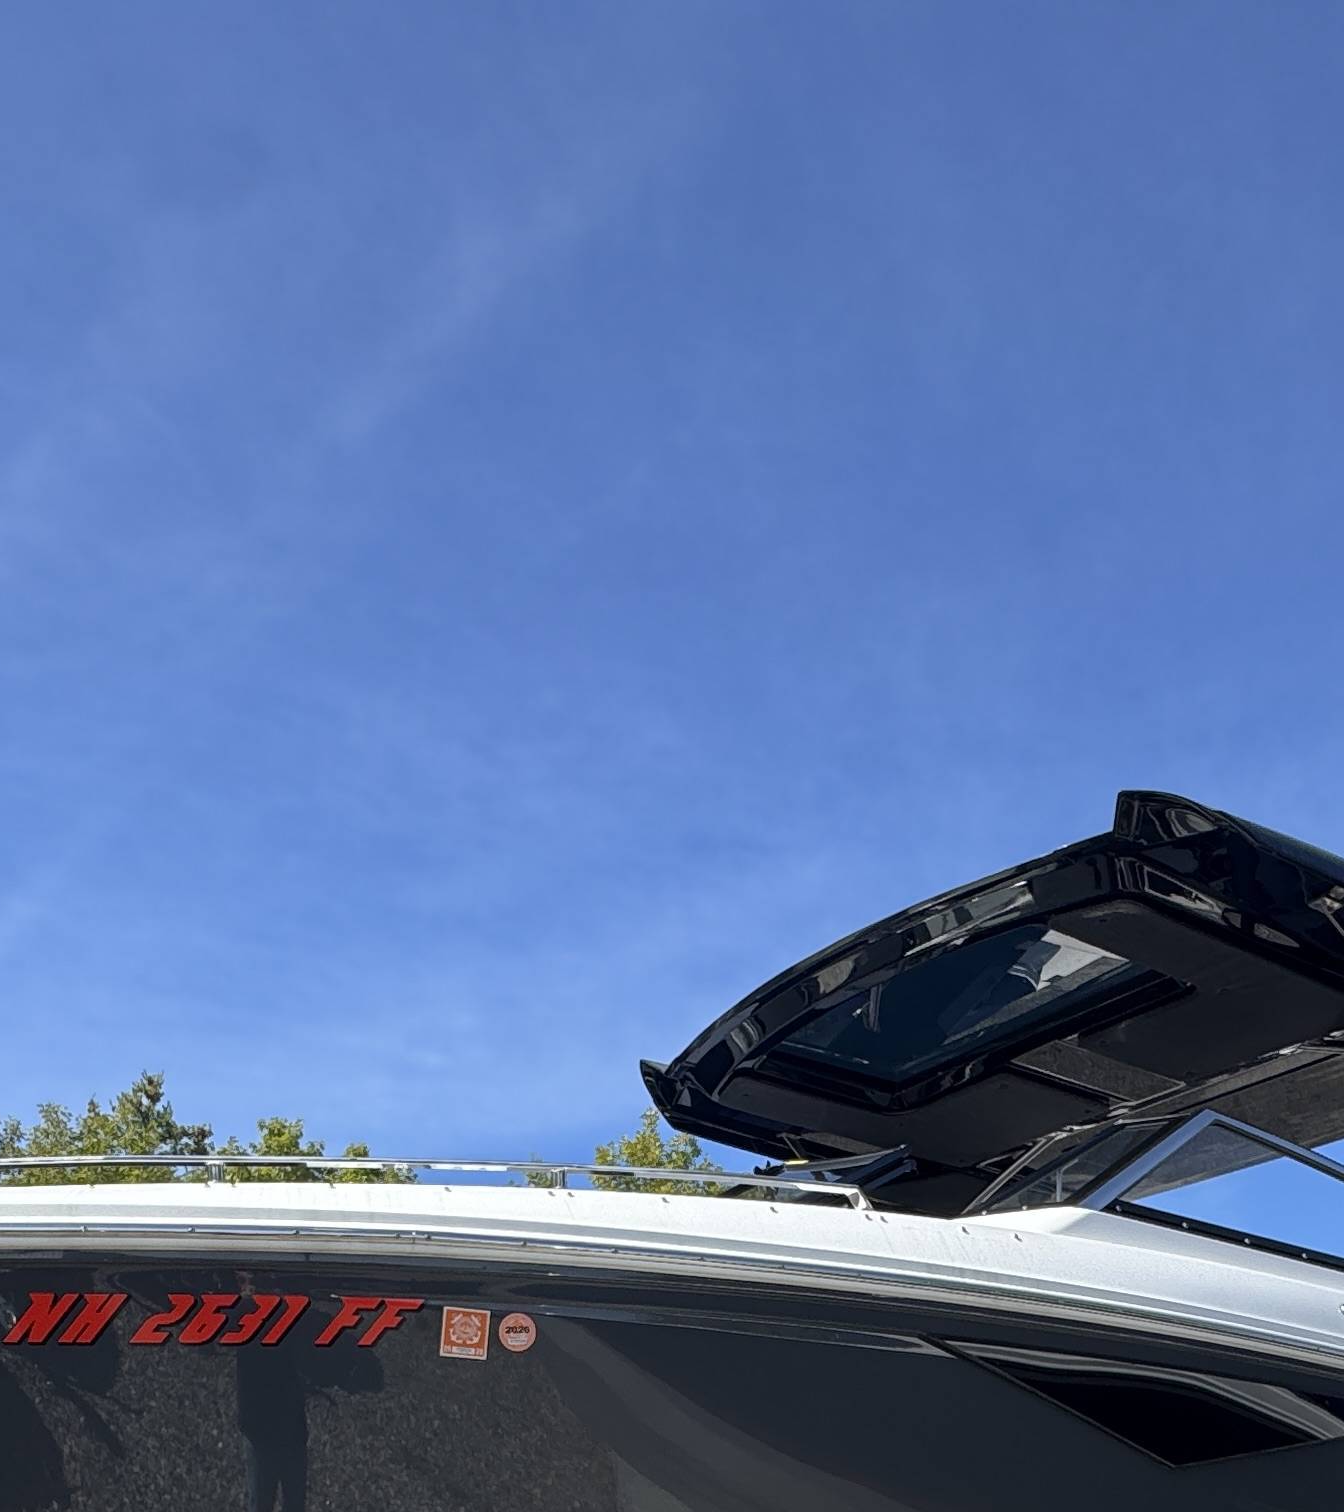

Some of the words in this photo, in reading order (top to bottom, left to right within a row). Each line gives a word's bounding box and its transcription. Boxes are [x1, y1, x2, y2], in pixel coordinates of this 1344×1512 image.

[2, 1292, 130, 1345] NH
[129, 1292, 312, 1346] 2631
[313, 1296, 426, 1347] FF
[505, 1326, 530, 1334] 2026
